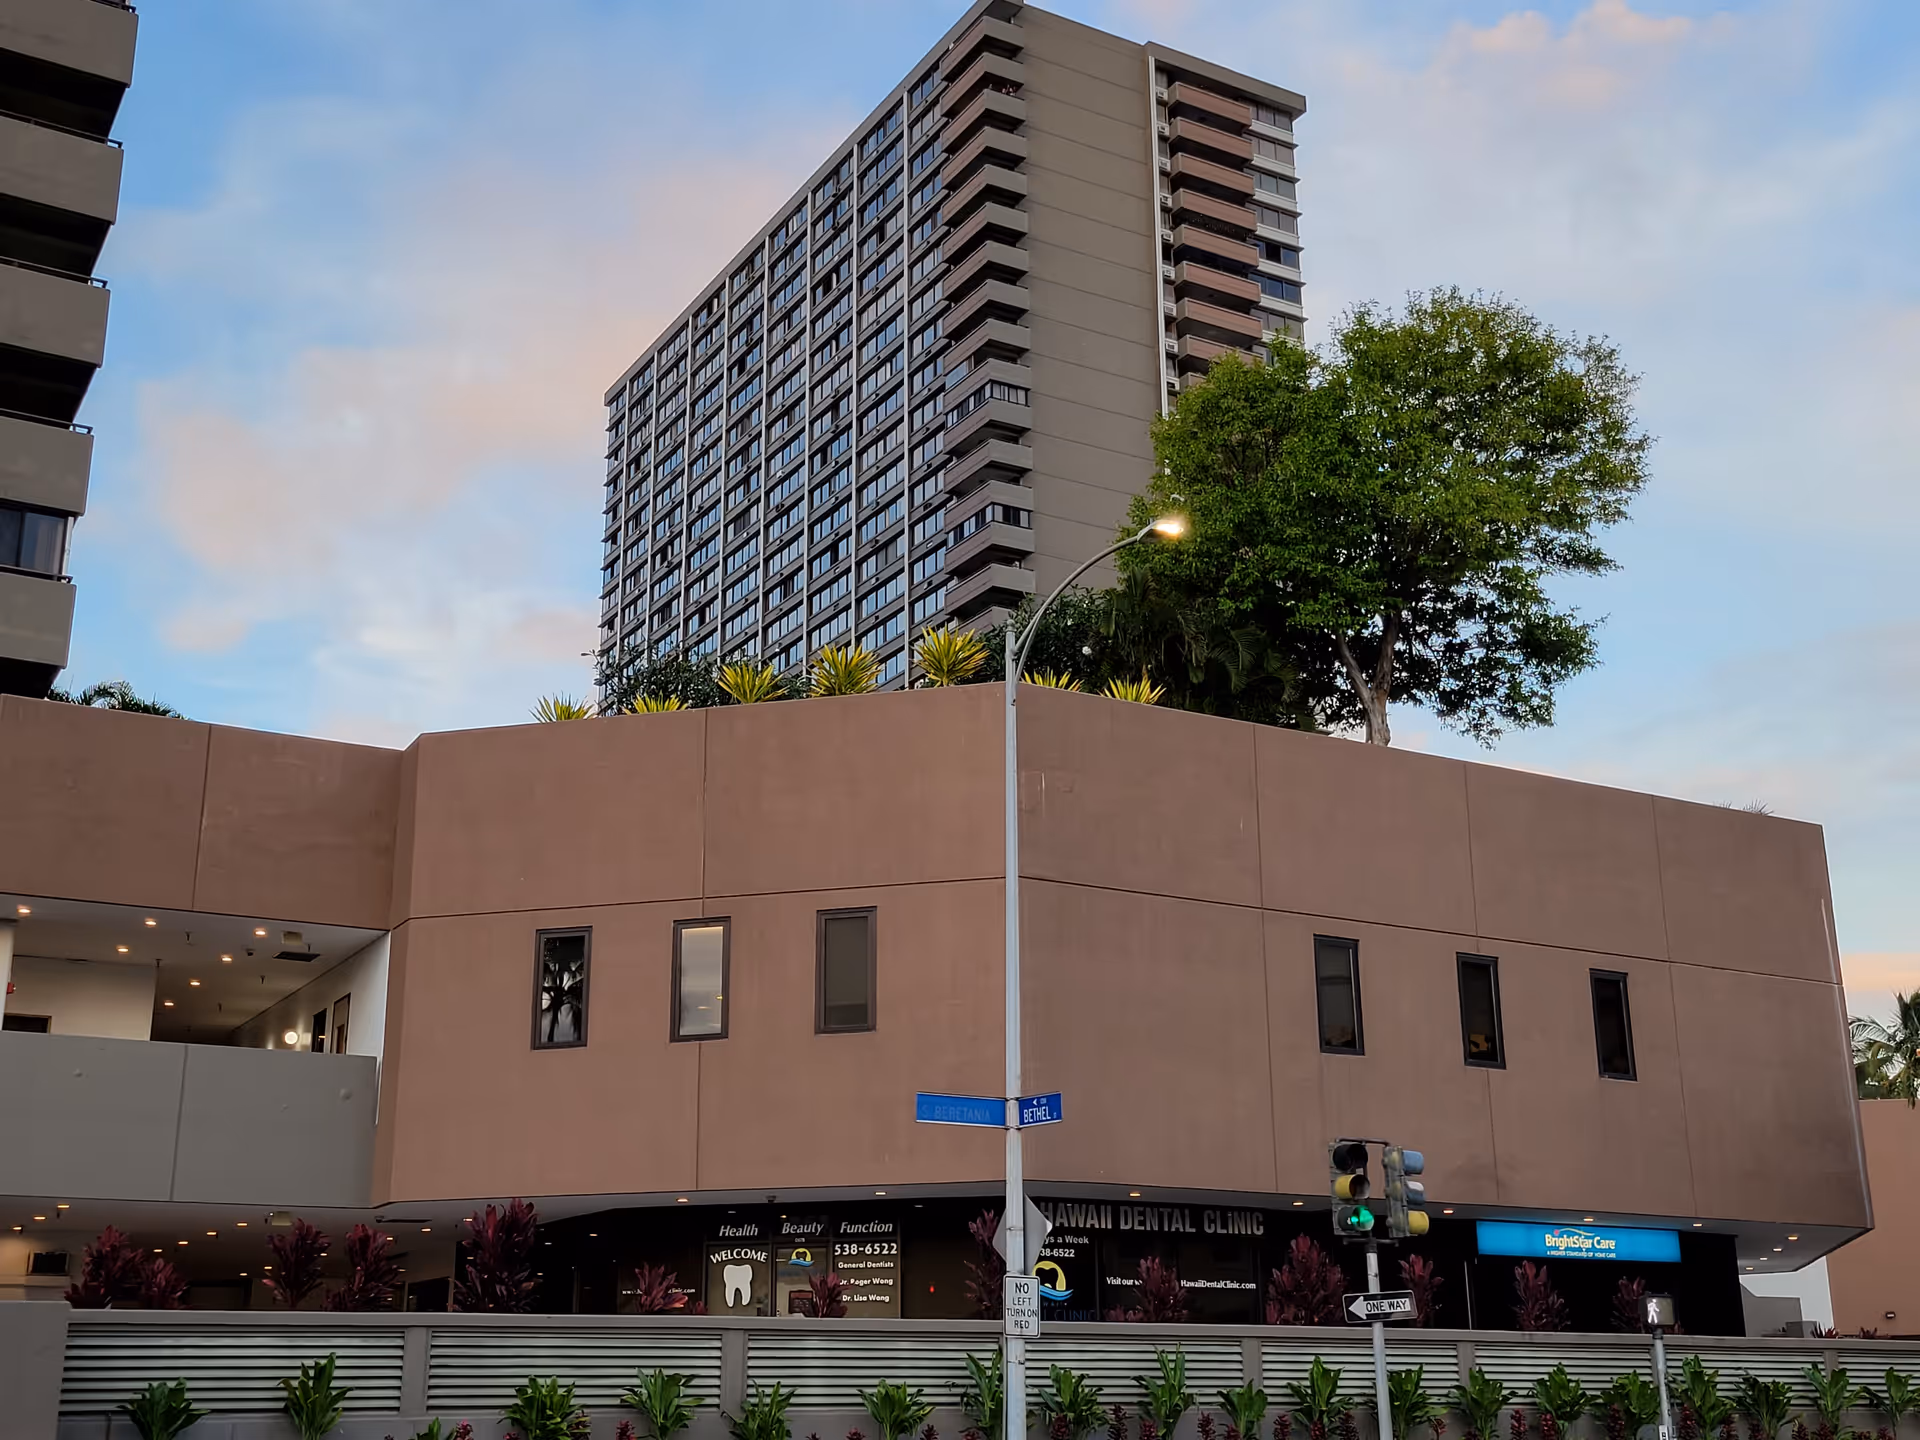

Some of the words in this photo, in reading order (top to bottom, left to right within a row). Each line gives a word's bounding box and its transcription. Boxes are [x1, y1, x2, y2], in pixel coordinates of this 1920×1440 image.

[934, 1106, 991, 1123] BERETANIA
[1023, 1106, 1051, 1123] BETHEL
[1040, 1202, 1112, 1230] HAWAII
[1119, 1205, 1196, 1233] DENTAL
[1203, 1209, 1264, 1235] CLINIC
[719, 1224, 758, 1237] Health
[781, 1222, 824, 1236] Beauty
[840, 1220, 893, 1234] Function
[1044, 1236, 1054, 1244] ys
[1065, 1235, 1089, 1244] Week
[1545, 1234, 1592, 1250] BrightStar
[1594, 1236, 1616, 1249] Care
[834, 1243, 897, 1256] 538-6522
[1040, 1248, 1075, 1257] 38-6522
[710, 1248, 768, 1264] WELCOME
[838, 1261, 866, 1269] General
[867, 1260, 894, 1268] Dentists
[872, 1277, 893, 1286] Wong
[1106, 1276, 1121, 1285] Visit
[1180, 1279, 1256, 1289] HawaiiDentalClinic.com
[1014, 1282, 1029, 1294] NO
[853, 1294, 867, 1302] Lisa
[868, 1294, 889, 1302] Wong
[1012, 1297, 1032, 1306] LEFT
[1365, 1301, 1386, 1312] ONE
[1387, 1299, 1407, 1311] WAY
[1007, 1308, 1026, 1317] TURN
[1027, 1308, 1037, 1317] ON
[1014, 1320, 1030, 1329] RED
